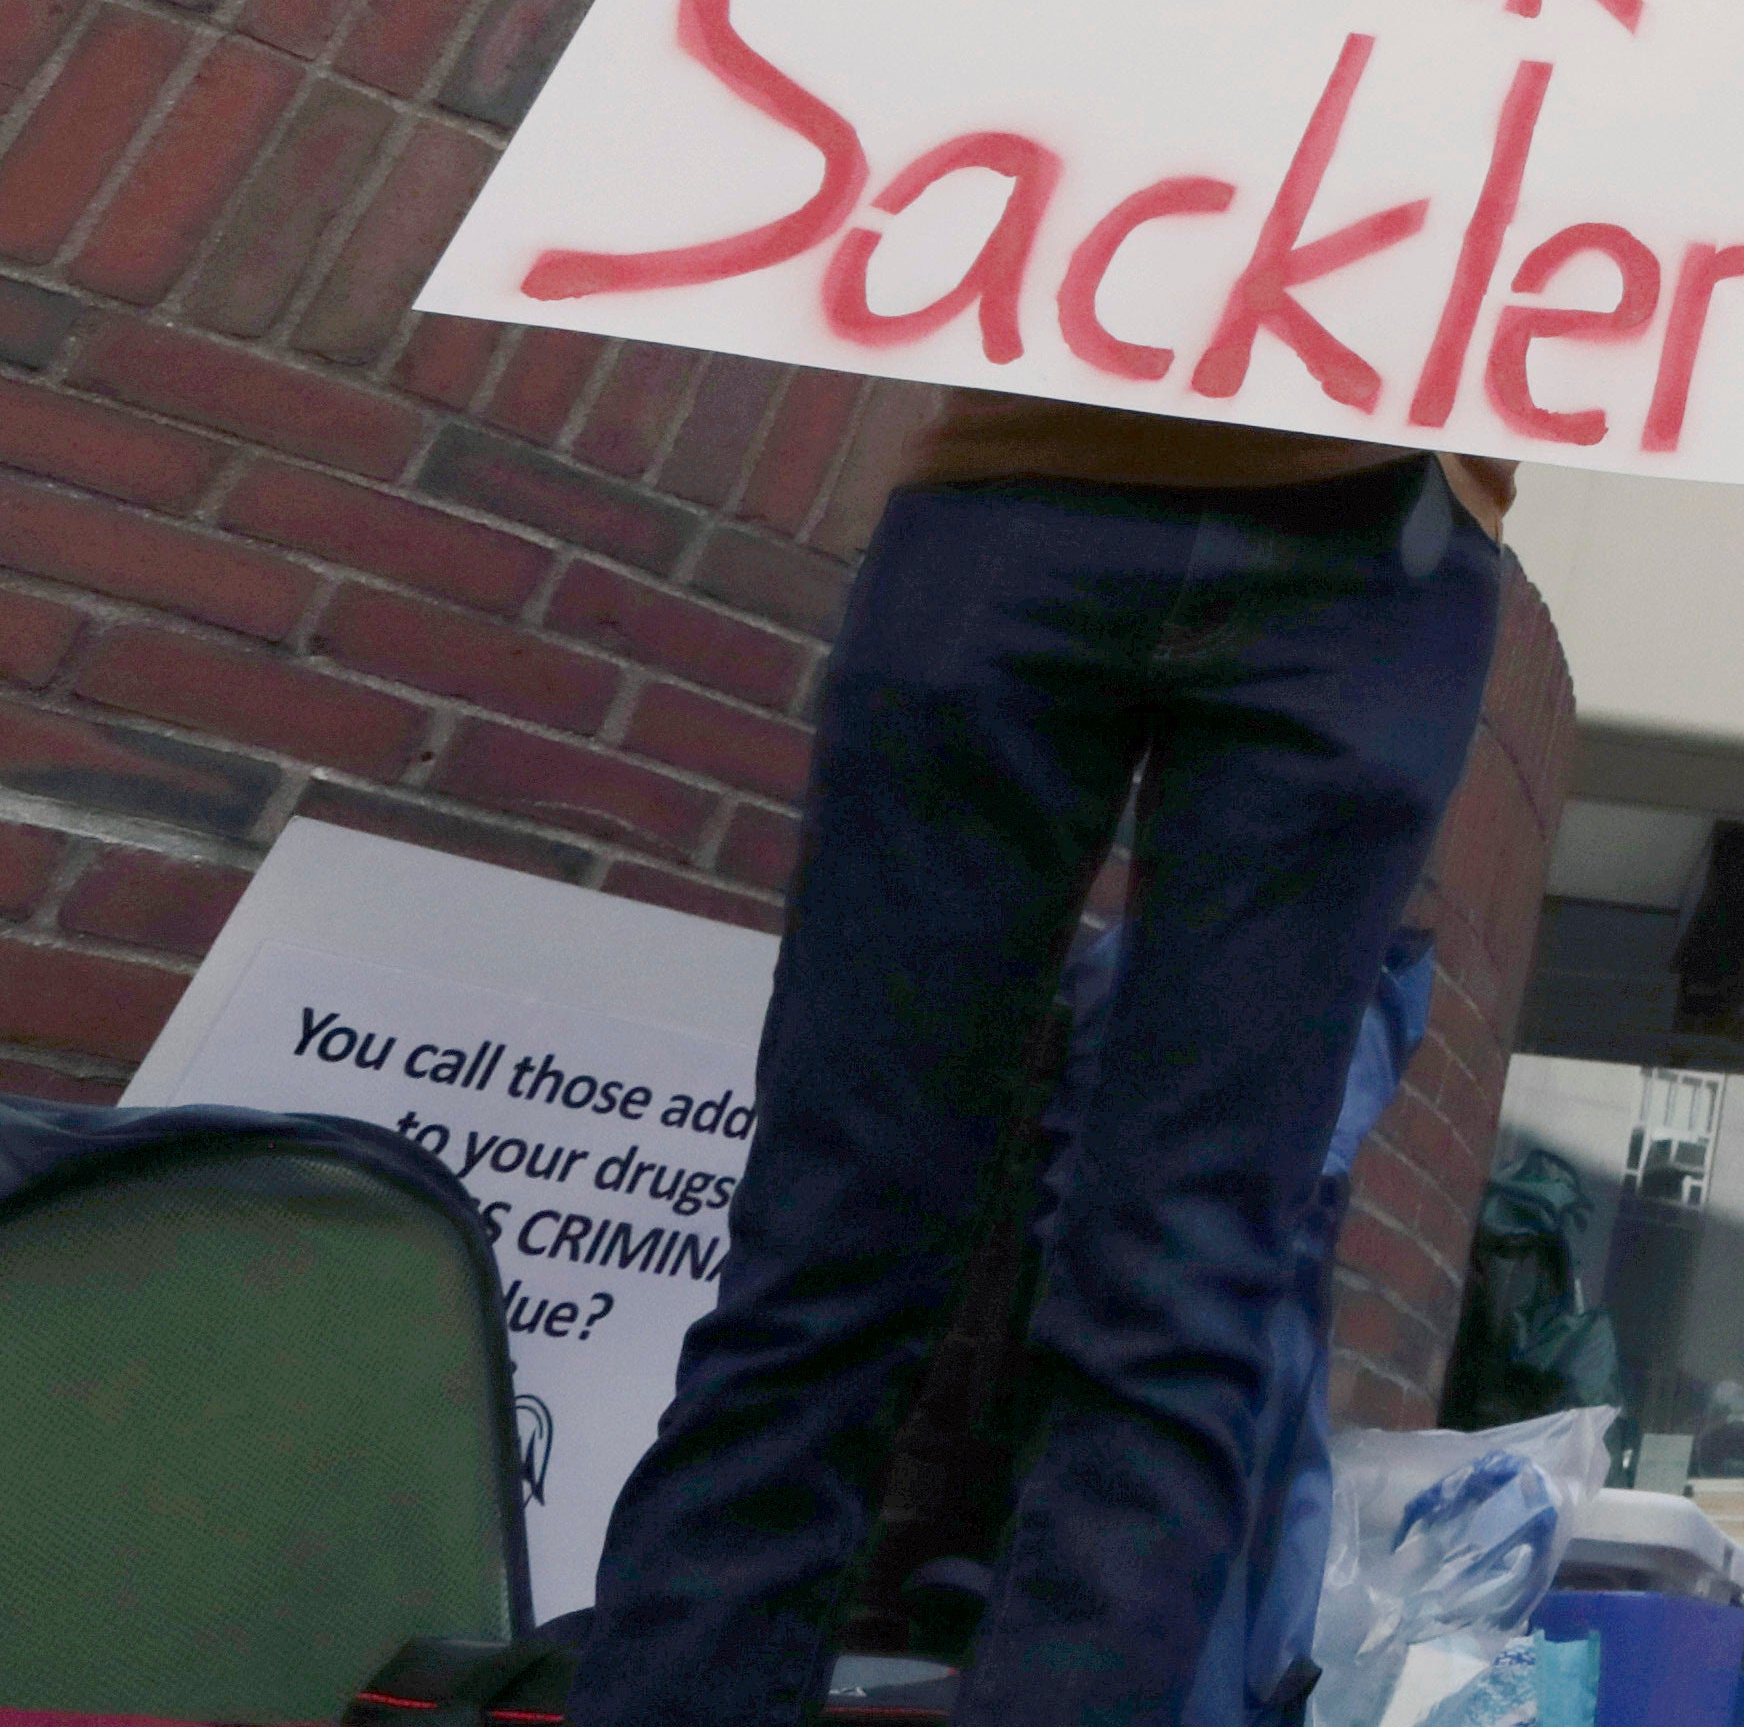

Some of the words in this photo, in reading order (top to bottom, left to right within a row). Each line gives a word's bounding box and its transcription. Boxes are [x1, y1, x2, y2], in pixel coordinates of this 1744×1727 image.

[293, 1006, 398, 1070] You
[403, 1039, 507, 1091] call
[507, 1053, 653, 1120] those
[454, 1130, 590, 1184] your
[593, 1145, 736, 1216] drugs
